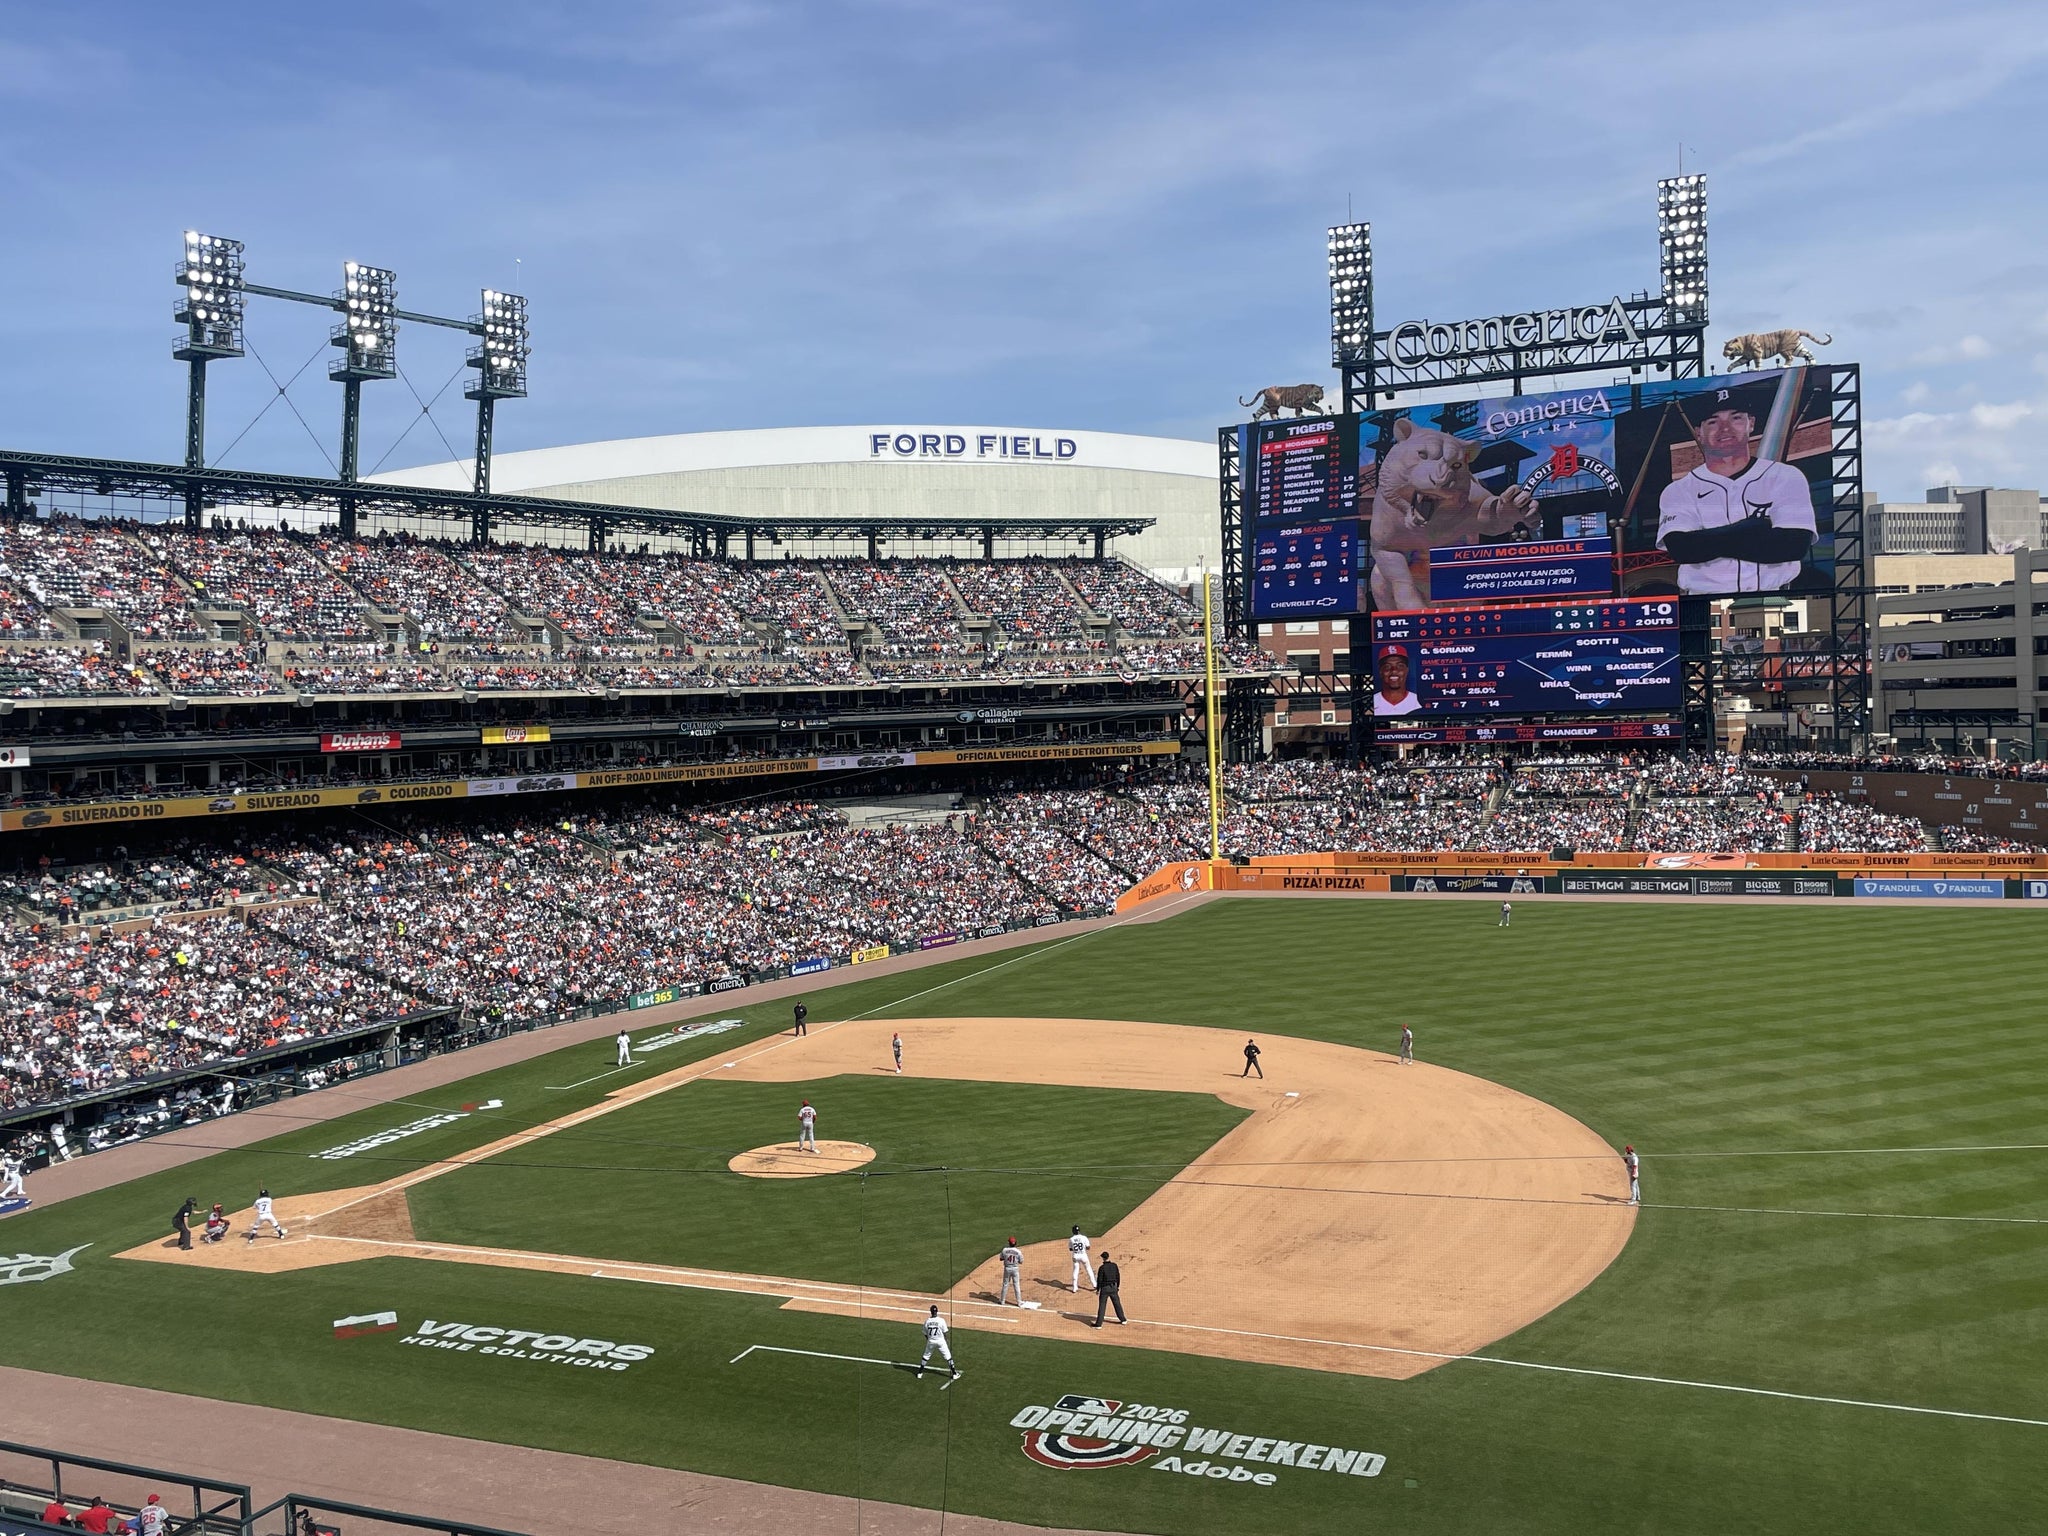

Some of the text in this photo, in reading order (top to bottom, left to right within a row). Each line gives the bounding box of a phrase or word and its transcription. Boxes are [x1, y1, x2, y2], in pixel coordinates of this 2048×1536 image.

[1387, 296, 1643, 369] Comerica
[1456, 347, 1572, 375] PARK
[1486, 390, 1611, 434] Comerica
[1287, 421, 1335, 436] TIGERS
[1523, 420, 1577, 438] PARK
[871, 434, 1077, 459] FORD FIELD
[1285, 438, 1325, 448] MCGONIGLE
[1286, 448, 1313, 456] TORRES
[1285, 454, 1325, 464] CARPENTER
[1285, 464, 1312, 472] GREENE
[1284, 472, 1314, 481] DINGLER
[1583, 458, 1619, 491] TIGERS
[1284, 479, 1325, 489] MCKINSTRY
[1284, 488, 1324, 497] TORKELSON
[1283, 496, 1320, 505] MEADOWS
[1280, 525, 1333, 536] 2026 SEASON
[1454, 543, 1584, 559] KEVIN MCGONIGLE
[1466, 572, 1500, 581] OPENING
[1501, 571, 1518, 579] DAY
[1463, 577, 1572, 589] 4-FOR-5 DOUBLES RBI
[1271, 600, 1315, 608] CHEVROLET
[1641, 603, 1672, 616] 1-0
[1211, 592, 1223, 649] Rocket
[1419, 617, 1427, 625] 0
[1421, 646, 1475, 655] G. SORIANO
[1536, 650, 1572, 658] FERMÍN
[1620, 647, 1664, 655] WALKER
[1606, 663, 1654, 671] SAGGESE
[1540, 680, 1570, 688] URÍAS
[1616, 677, 1670, 685] BURLESON
[1576, 692, 1623, 700] HERRERA
[977, 709, 1023, 718] Gallagher
[681, 721, 724, 731] CHAMPIONS
[506, 727, 526, 740] Lay's
[331, 732, 390, 747] Dunham's
[956, 745, 1143, 762] OFFICIAL VEHICLE OF THE DETROIT TIGERS
[589, 761, 809, 785] AN OFF-ROAD LINEUP THAT'S IN A LEAGUE OF ITS OWN
[1852, 776, 1863, 786] 23
[1945, 780, 1950, 790] 5
[390, 785, 453, 799] COLORADO
[1994, 784, 2000, 795] 2
[246, 793, 320, 809] SILVERADO
[62, 804, 164, 823] SILVERADO HD
[1966, 804, 1978, 814] 47
[2020, 809, 2026, 819] 3
[1357, 855, 1438, 863] Little Caesars DELIVERY
[1457, 855, 1542, 864] Little Caesars DELIVERY
[1811, 856, 1910, 866] Little Caesars DELIVERY
[1933, 856, 2036, 866] Little Caesars DELIVERY
[1283, 877, 1364, 889] PIZZA! PIZZA!
[1576, 880, 1624, 891] BETMGM
[1641, 881, 1689, 892] BETMGM
[1879, 884, 1923, 892] FANDUEL
[1949, 885, 1993, 893] FANDUEL
[1036, 914, 1060, 927] Comerica
[979, 925, 1005, 938] Comerica
[709, 976, 746, 994] Comerica
[637, 990, 672, 1006] bet365
[1074, 1243, 1083, 1251] 28
[1007, 1255, 1015, 1263] 41
[928, 1327, 938, 1335] 77
[416, 1319, 656, 1362] VICTORS
[399, 1336, 630, 1371] HOME SOLUTIONS
[1120, 1404, 1189, 1425] 2026
[1009, 1405, 1387, 1477] OPENING WEEKEND
[1150, 1457, 1277, 1486] Adobe
[143, 1513, 156, 1525] 26
